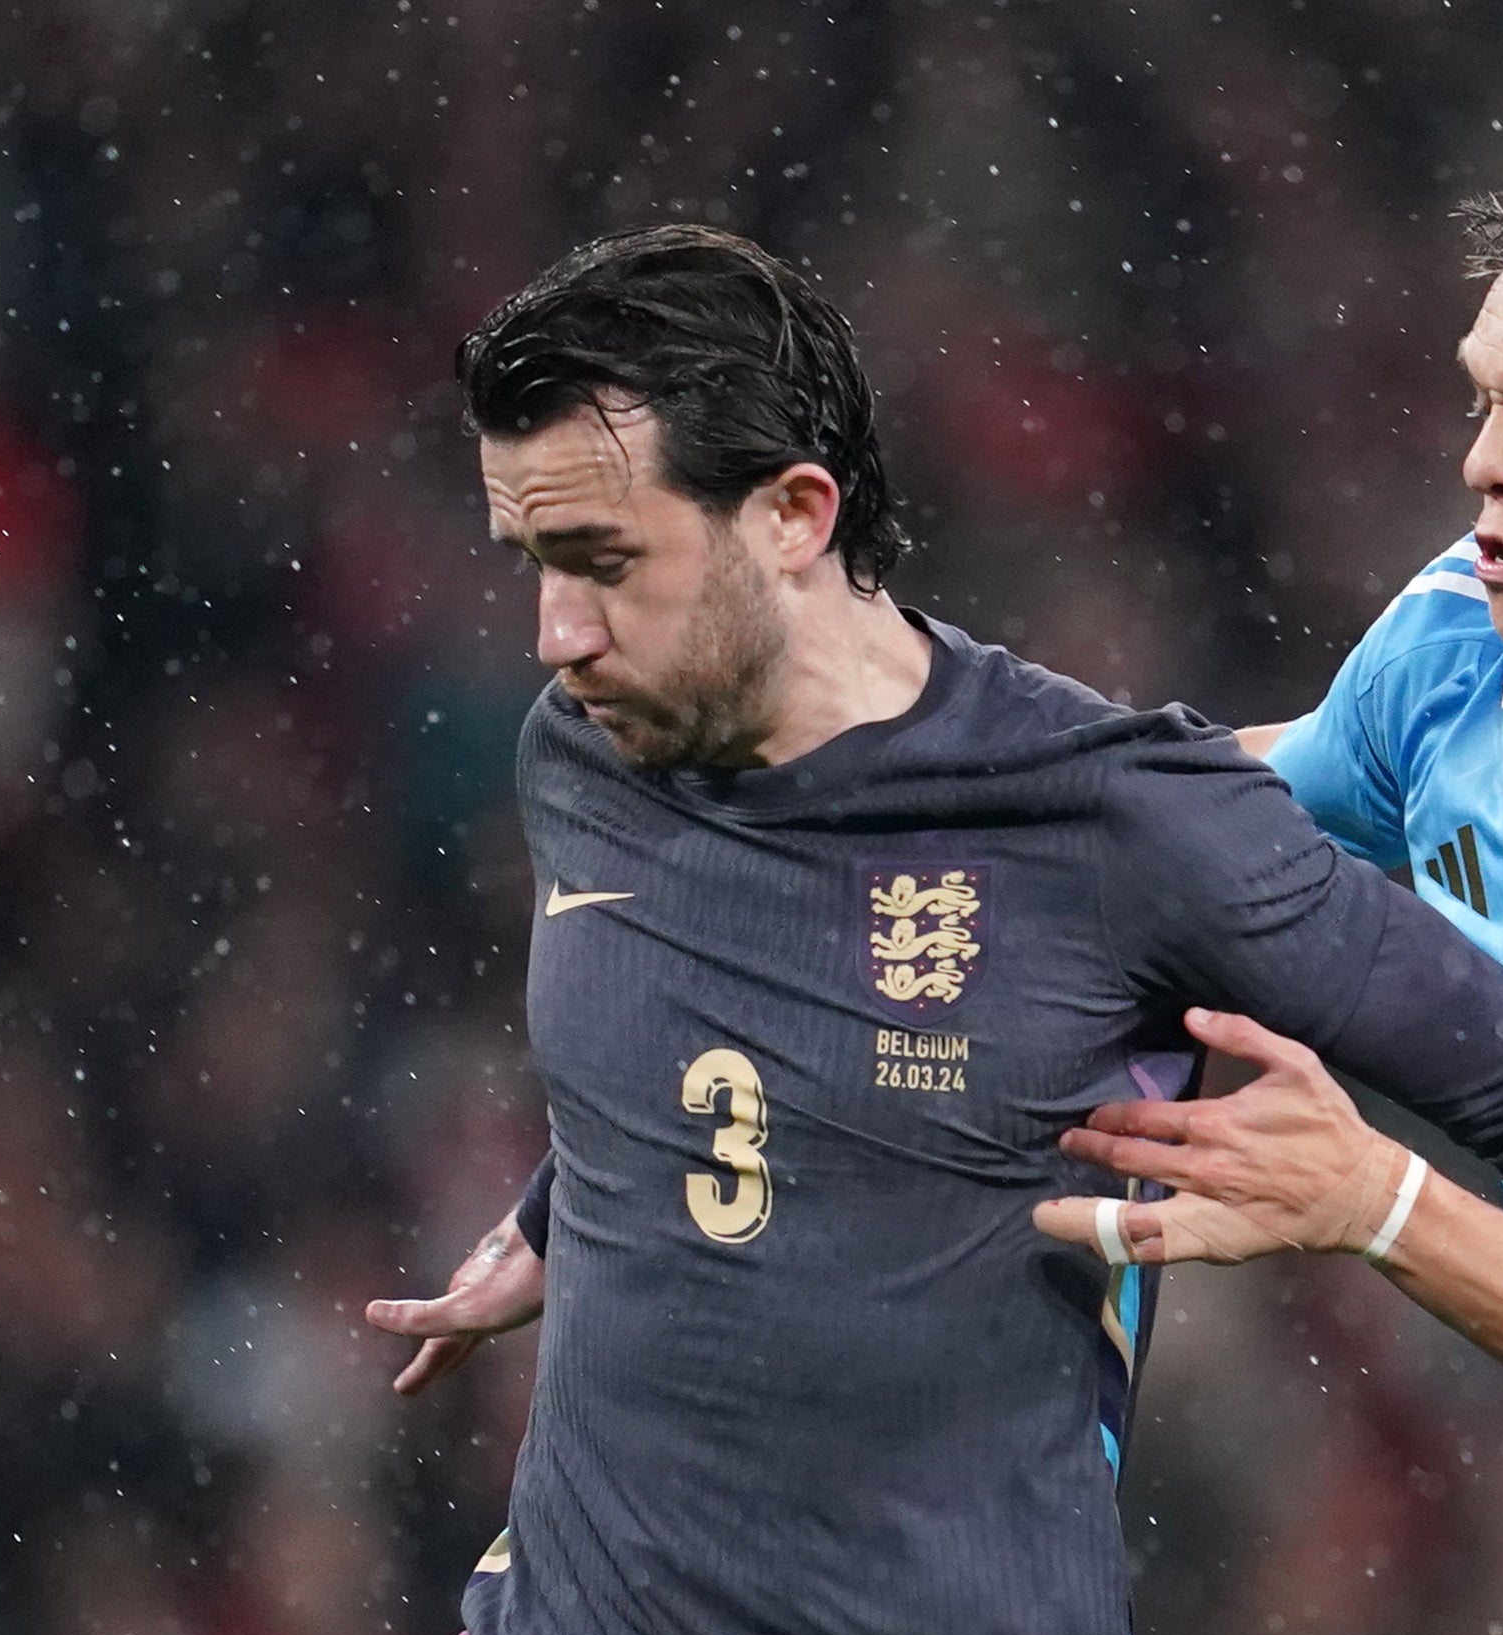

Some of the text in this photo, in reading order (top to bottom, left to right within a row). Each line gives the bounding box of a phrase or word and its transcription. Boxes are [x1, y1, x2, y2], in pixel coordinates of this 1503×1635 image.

[876, 1029, 969, 1061] BELGIUM
[876, 1061, 966, 1092] 26.03.24
[682, 1048, 773, 1244] 3
